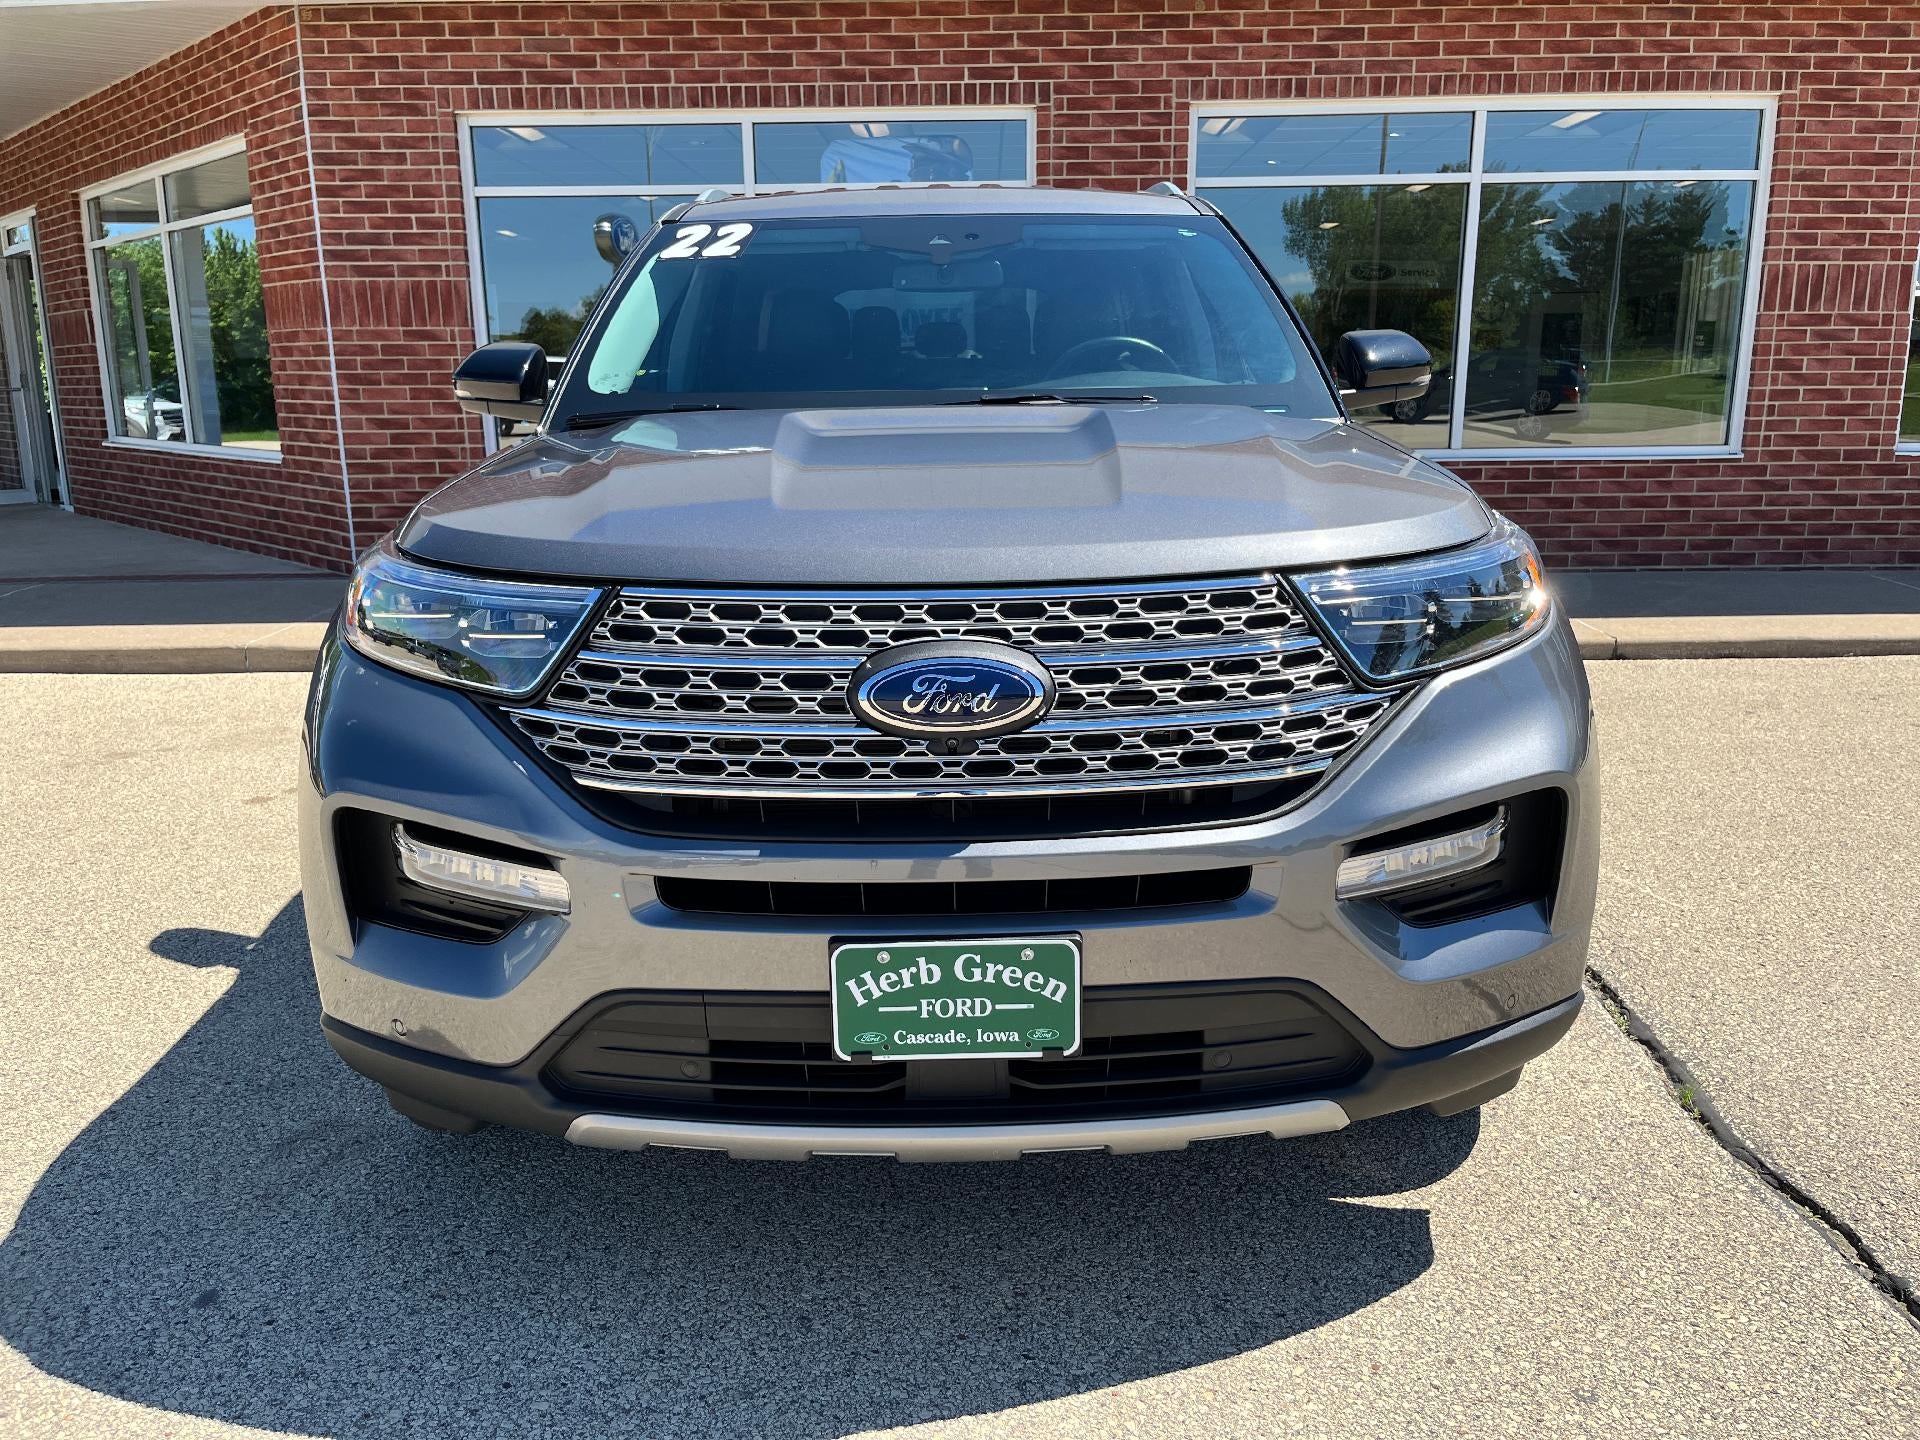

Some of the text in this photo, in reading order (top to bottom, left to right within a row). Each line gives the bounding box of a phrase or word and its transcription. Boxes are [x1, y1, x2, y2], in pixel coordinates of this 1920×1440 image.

[660, 223, 753, 258] 22
[902, 674, 1000, 713] Ford
[844, 953, 1068, 1007] Herb Green
[920, 998, 993, 1019] FORD
[860, 1033, 881, 1042] Ford
[893, 1028, 1020, 1046] Cascade, Iowa
[1033, 1029, 1053, 1039] Ford
